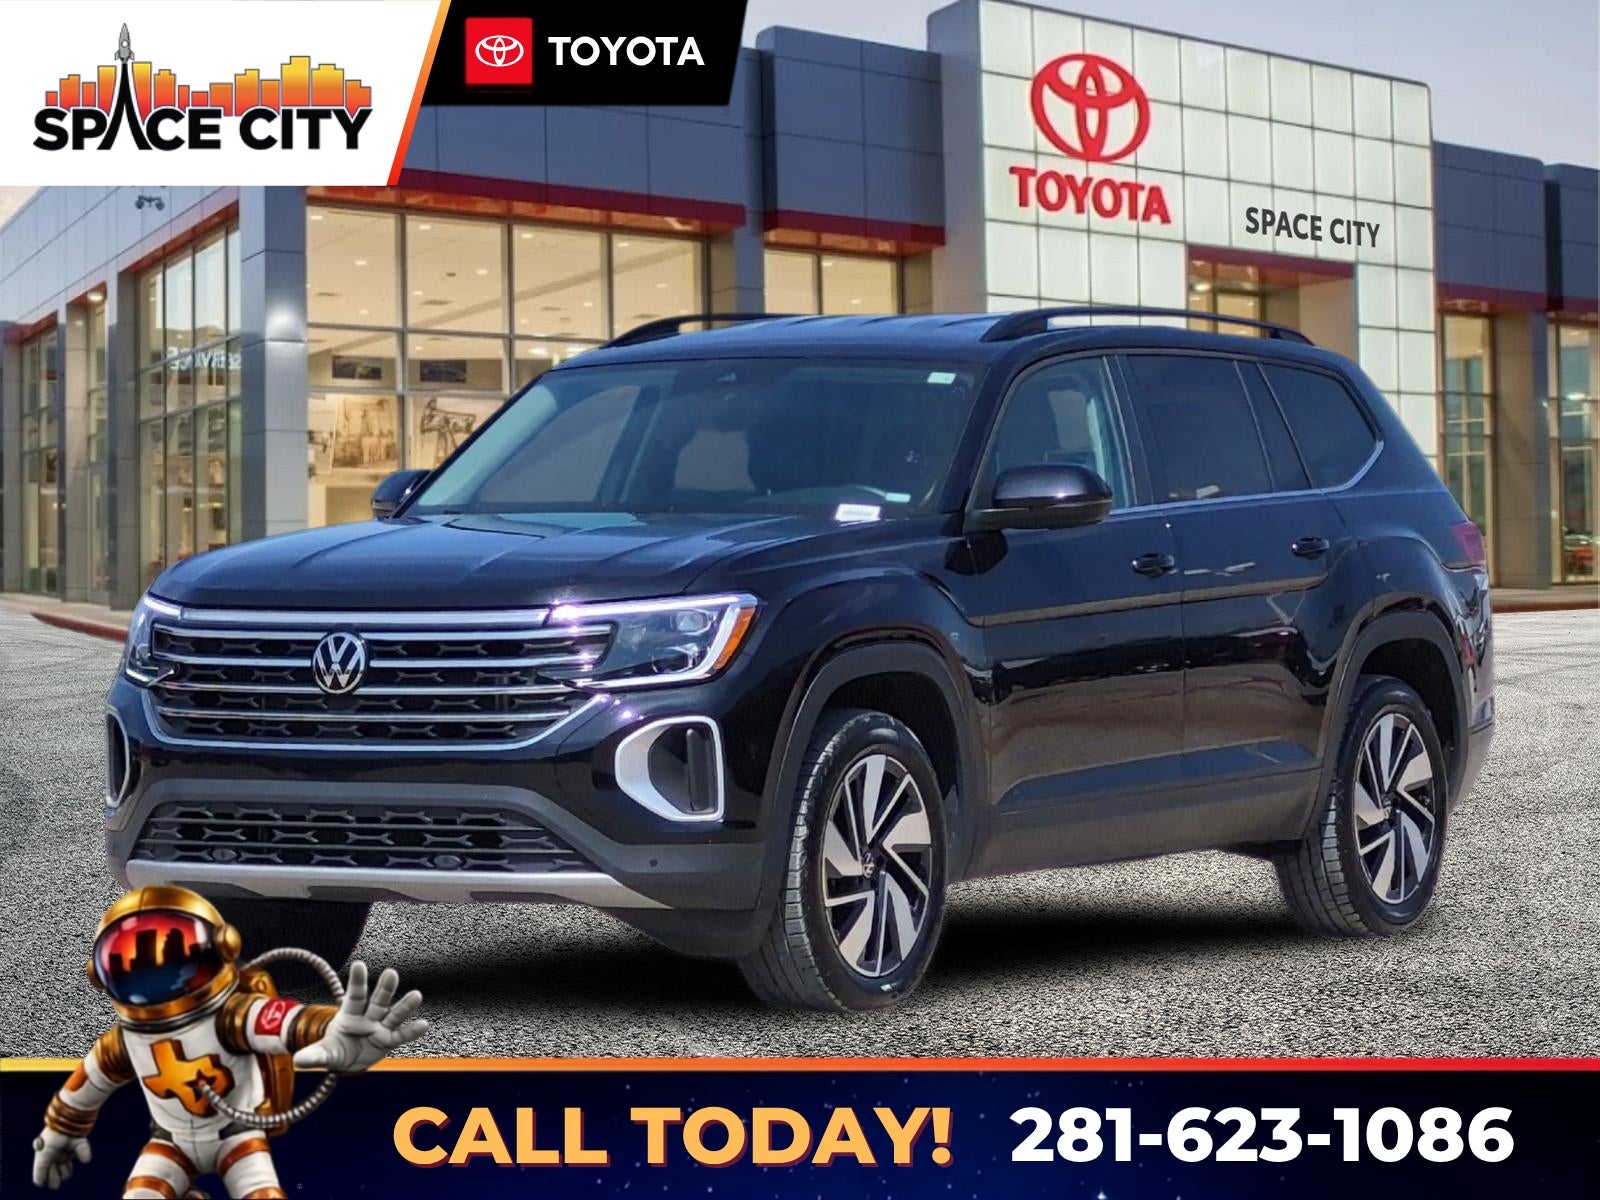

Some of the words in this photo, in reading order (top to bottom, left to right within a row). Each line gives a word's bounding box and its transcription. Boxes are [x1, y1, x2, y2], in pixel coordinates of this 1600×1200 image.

[1009, 165, 1171, 225] TOYOTA
[1245, 207, 1323, 242] SPACE
[1329, 217, 1380, 248] CITY
